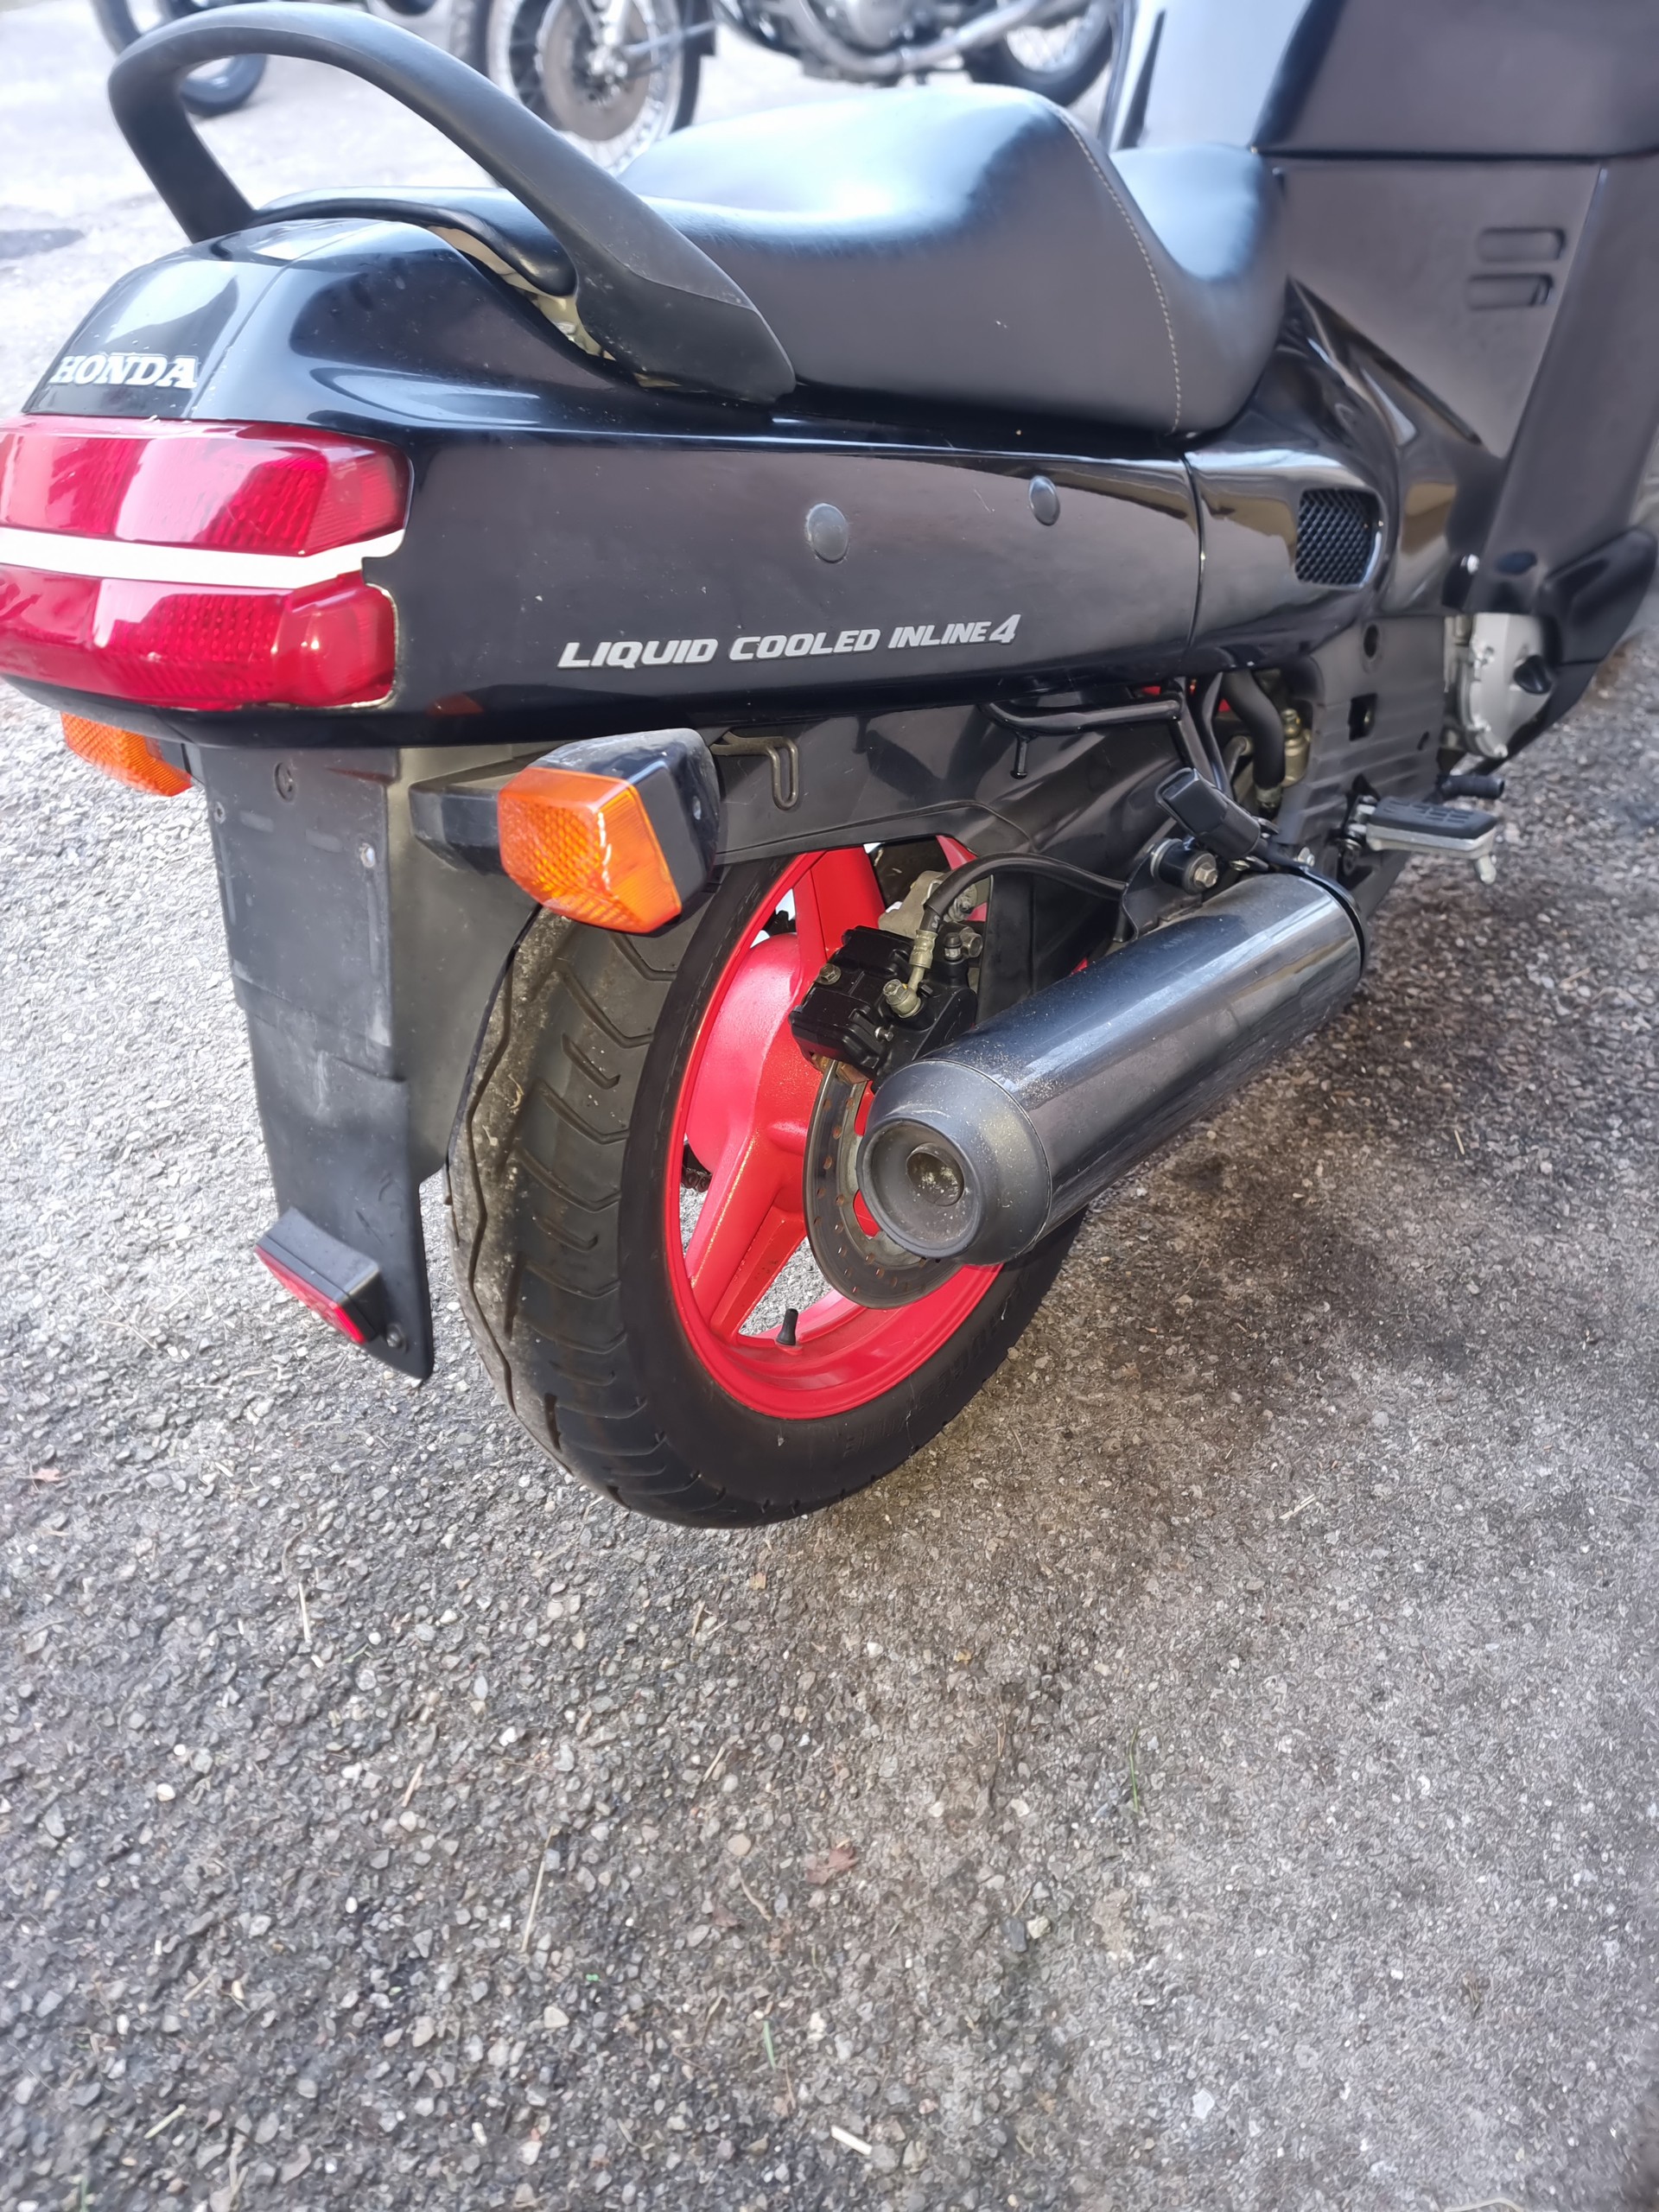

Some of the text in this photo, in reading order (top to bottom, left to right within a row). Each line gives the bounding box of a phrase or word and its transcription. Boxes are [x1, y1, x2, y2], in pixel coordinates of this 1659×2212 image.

[49, 353, 199, 388] HONDA
[557, 638, 718, 669] LIQUID
[729, 629, 880, 661] COOLED
